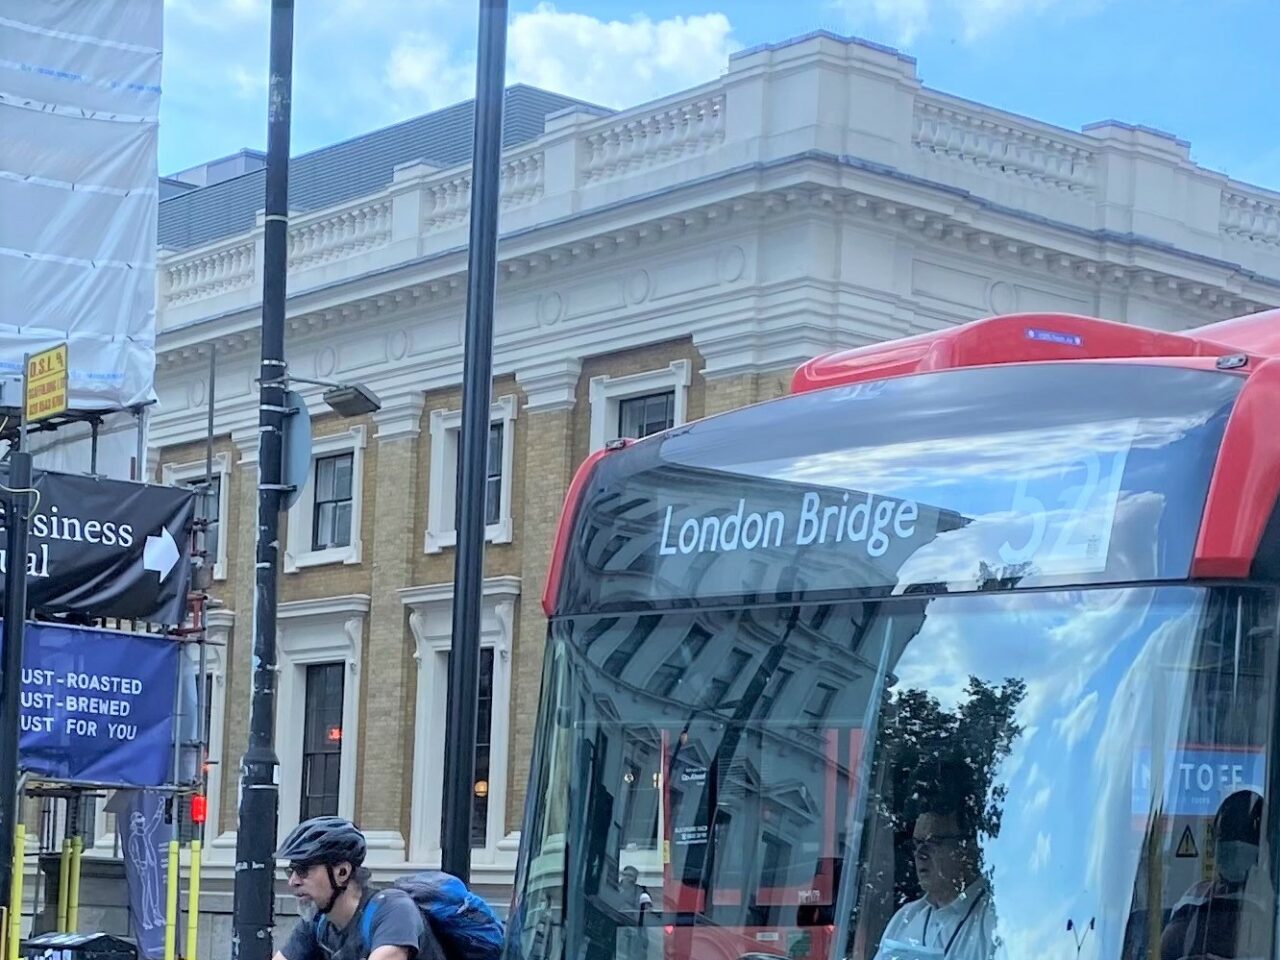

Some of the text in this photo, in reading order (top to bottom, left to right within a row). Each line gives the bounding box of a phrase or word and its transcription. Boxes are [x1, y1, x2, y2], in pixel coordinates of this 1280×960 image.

[0, 505, 133, 548] siness
[659, 499, 785, 555] London
[796, 492, 919, 557] Bridge
[21, 668, 142, 695] UST-ROASTED
[21, 691, 131, 717] UST-BREWED
[20, 714, 137, 740] UST FOR YOU
